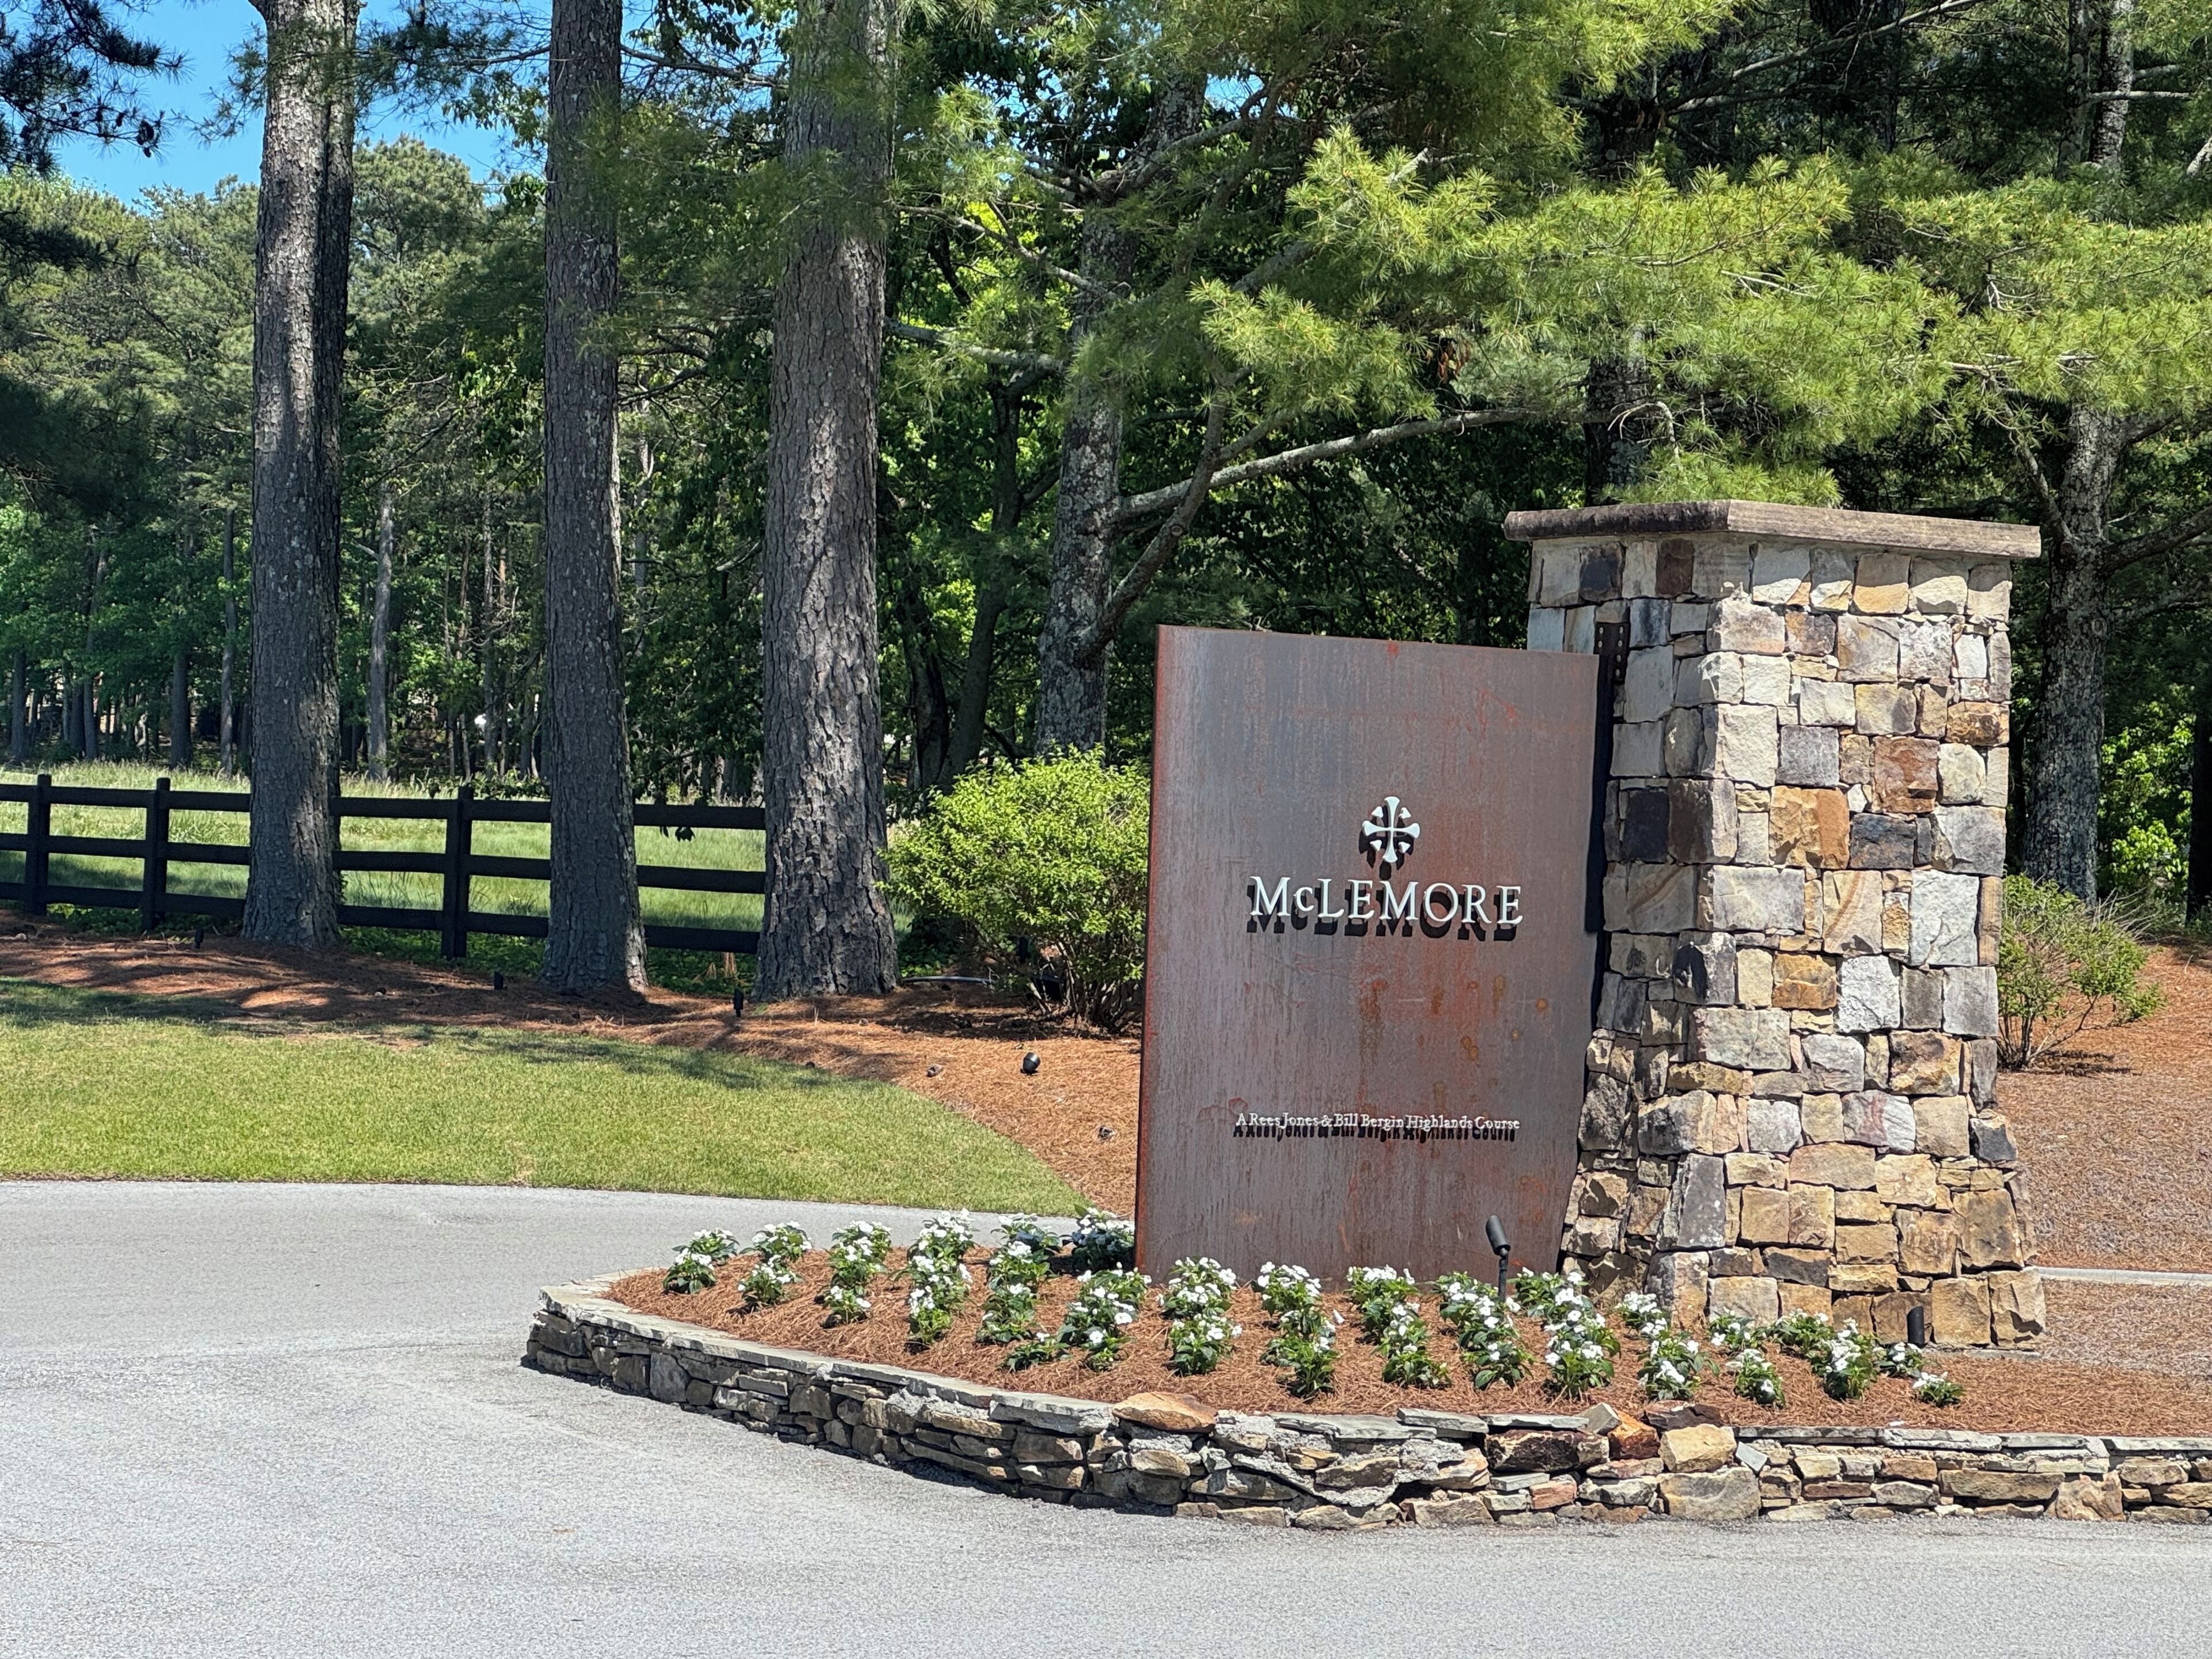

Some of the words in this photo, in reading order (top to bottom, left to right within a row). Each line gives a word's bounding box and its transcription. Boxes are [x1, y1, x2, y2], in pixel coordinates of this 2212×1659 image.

[1249, 876, 1523, 925] McLEMORE
[1236, 1112, 1247, 1126] A
[1249, 1113, 1281, 1126] Rees
[1278, 1112, 1319, 1129] Jones
[1319, 1115, 1333, 1127] &
[1334, 1113, 1358, 1127] Bill
[1361, 1114, 1404, 1131] Bergin
[1405, 1115, 1472, 1132] Highlands
[1474, 1116, 1520, 1129] Course
